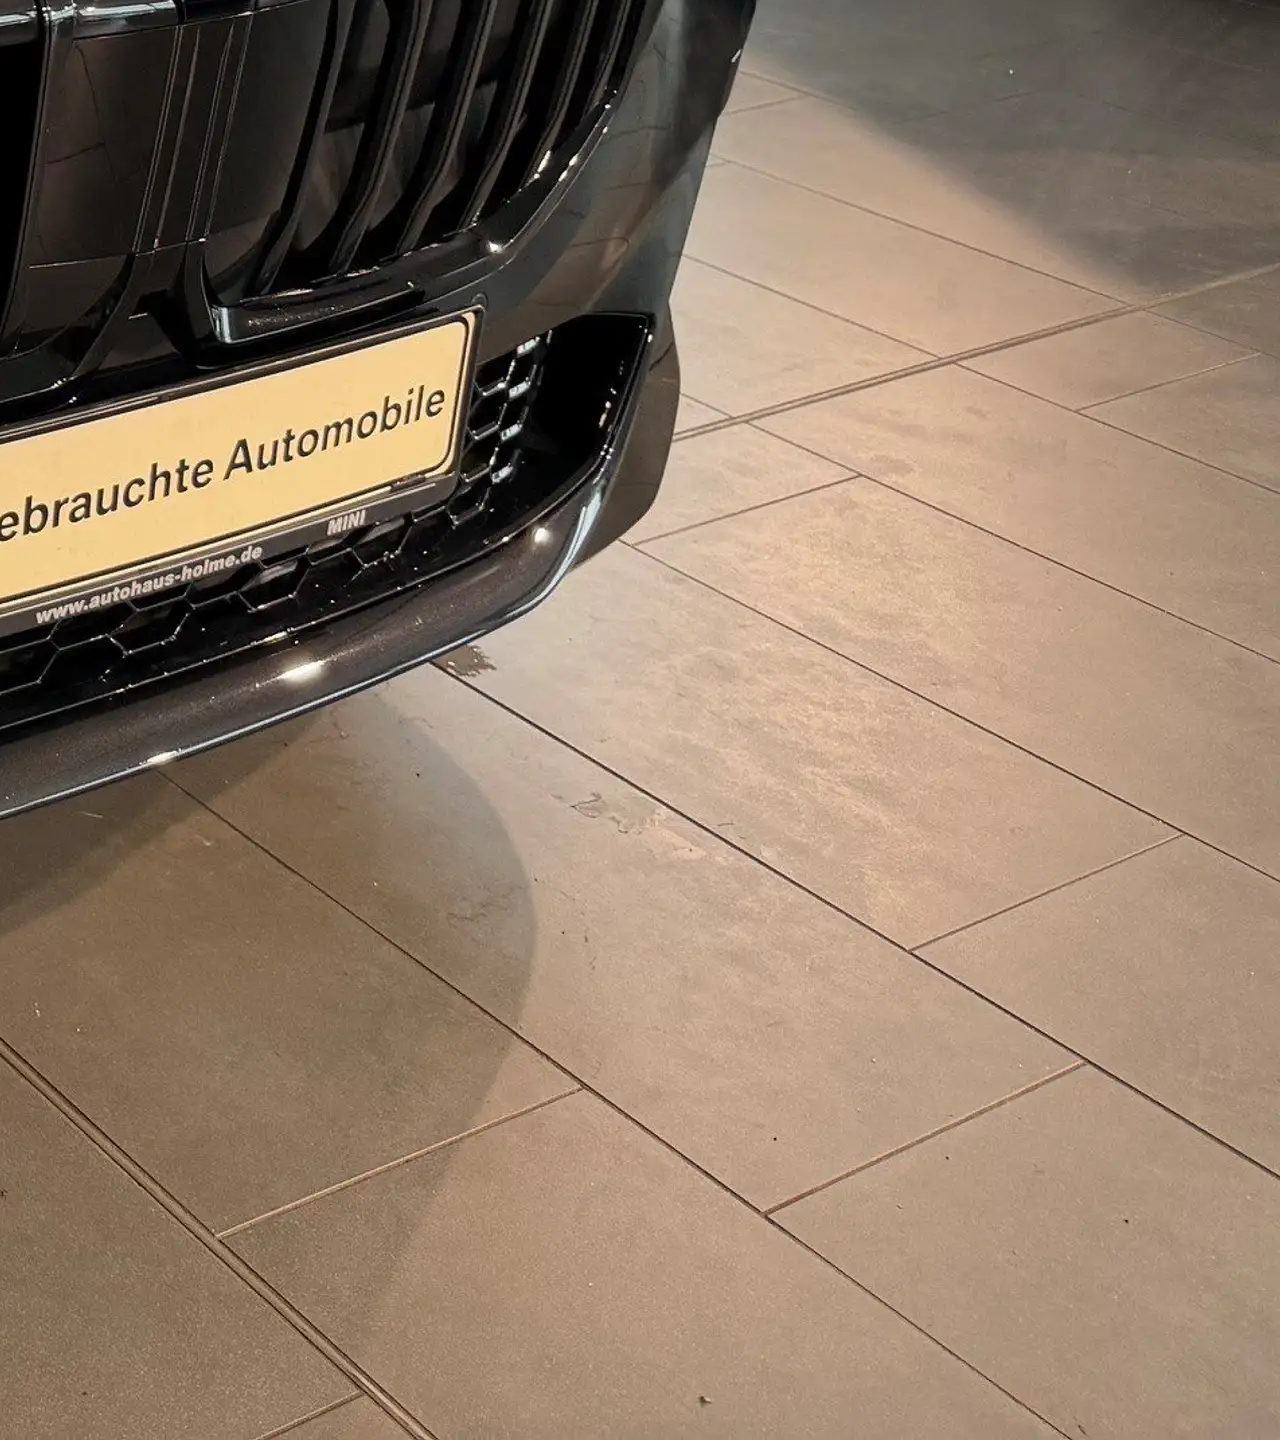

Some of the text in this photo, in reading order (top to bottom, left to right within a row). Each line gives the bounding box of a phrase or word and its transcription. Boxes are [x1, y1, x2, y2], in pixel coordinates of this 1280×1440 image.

[223, 385, 445, 480] Automobile
[36, 545, 263, 625] www.autohaus-holme.de
[326, 510, 366, 537] MINI
